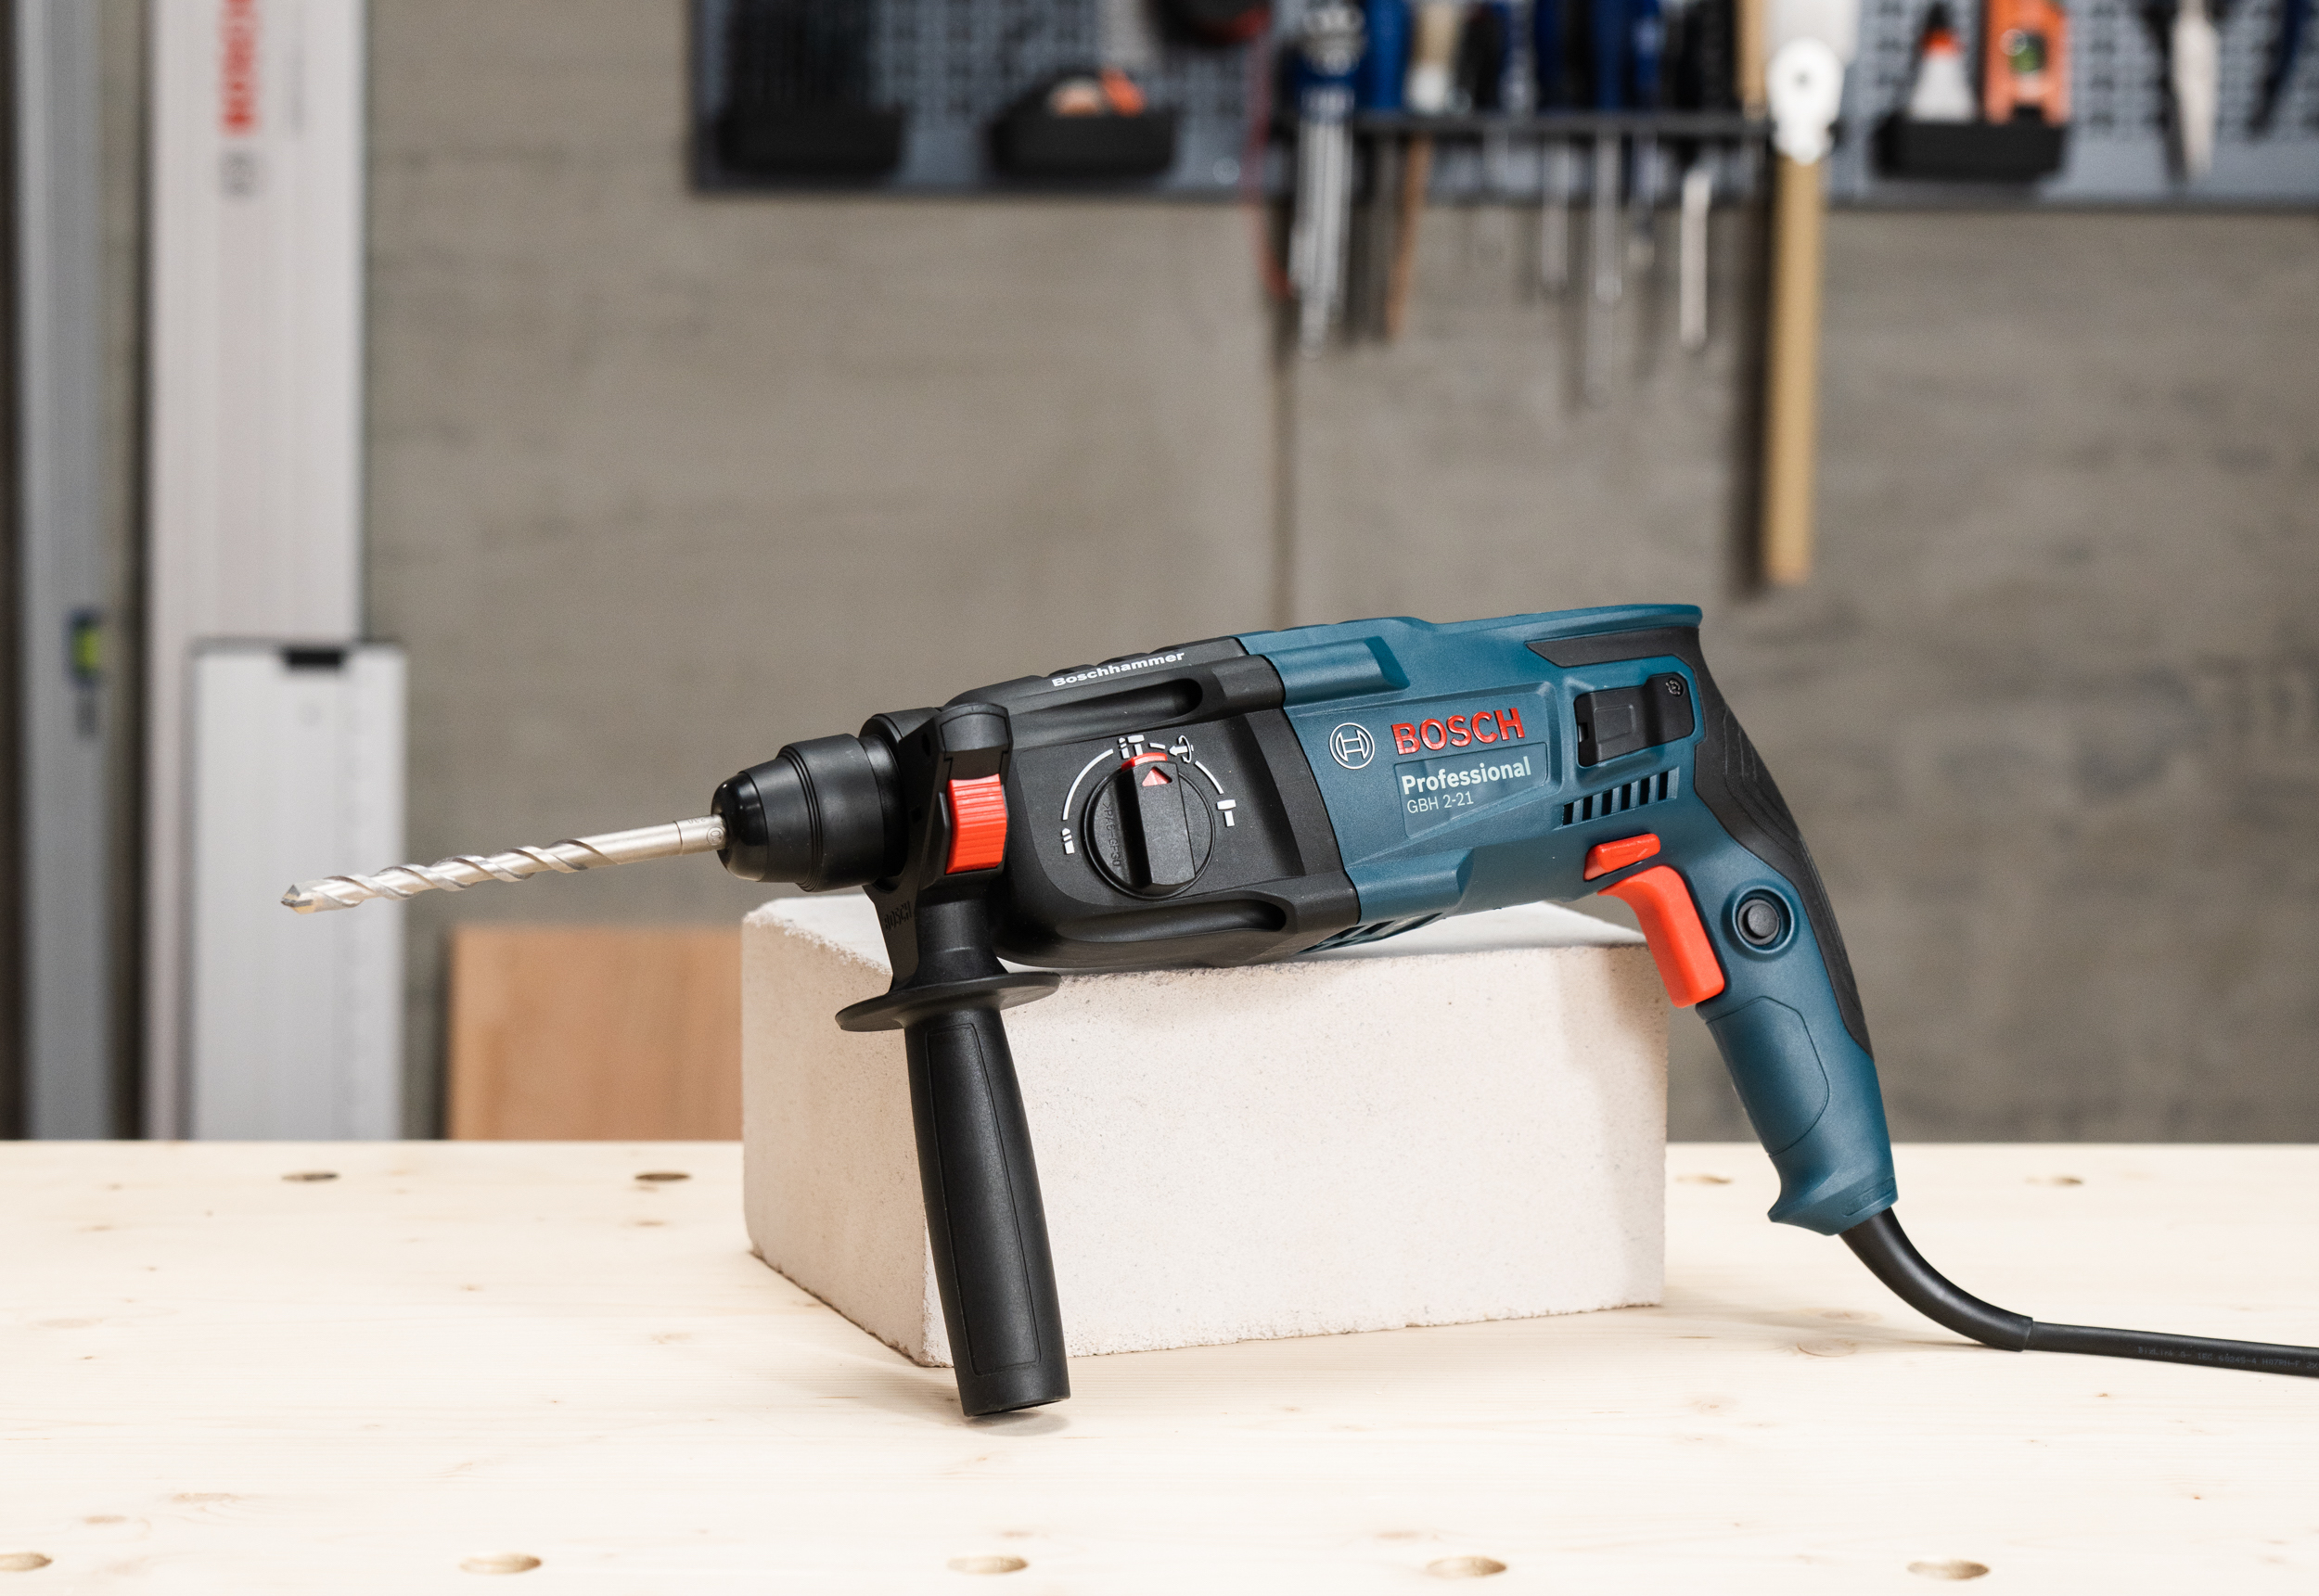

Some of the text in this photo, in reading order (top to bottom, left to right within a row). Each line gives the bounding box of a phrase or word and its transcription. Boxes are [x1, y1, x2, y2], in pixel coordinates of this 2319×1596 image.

[1052, 652, 1185, 687] Boschhammer
[1390, 708, 1526, 755] BOSCH
[1402, 756, 1531, 795] Professional
[1406, 791, 1474, 814] GBH 2-21
[884, 900, 912, 930] BOSCH
